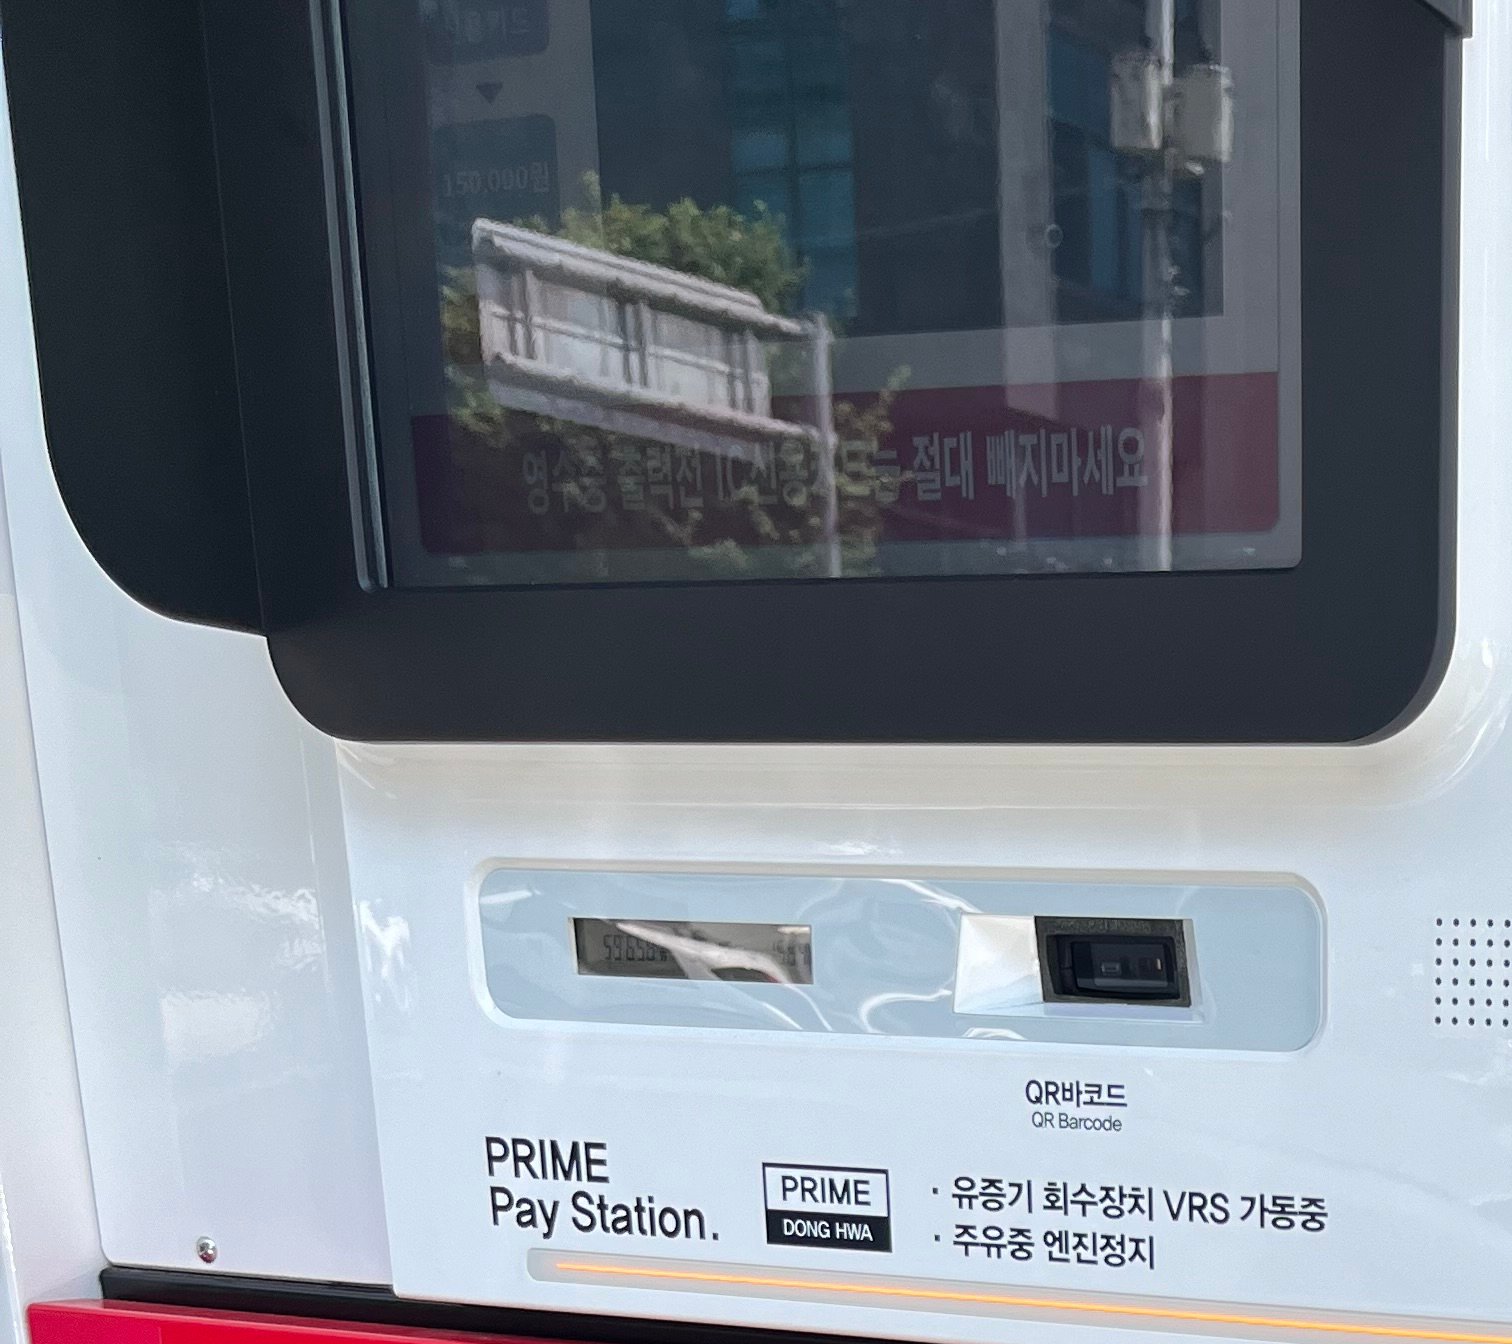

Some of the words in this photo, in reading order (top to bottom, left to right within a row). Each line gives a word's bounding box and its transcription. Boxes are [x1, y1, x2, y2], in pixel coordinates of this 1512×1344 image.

[521, 447, 608, 515] 영수증
[911, 430, 976, 501] 절대
[986, 423, 1149, 499] 빼지마세요
[1025, 1079, 1128, 1108] QR바코드
[1031, 1111, 1056, 1129] QR
[1058, 1113, 1123, 1132] Barcode
[485, 1136, 610, 1184] PRIME
[488, 1185, 560, 1240] Pay
[570, 1190, 720, 1241] Station.
[780, 1174, 872, 1206] PRIME
[951, 1175, 1035, 1213] 유증기
[1042, 1181, 1155, 1221] 회수장치
[1163, 1189, 1231, 1225] VRS
[1240, 1193, 1329, 1232] 가동중
[782, 1218, 831, 1240] DONG
[834, 1221, 874, 1242] HWA
[952, 1223, 1036, 1262] 주유중
[1043, 1229, 1155, 1270] 엔진정지
